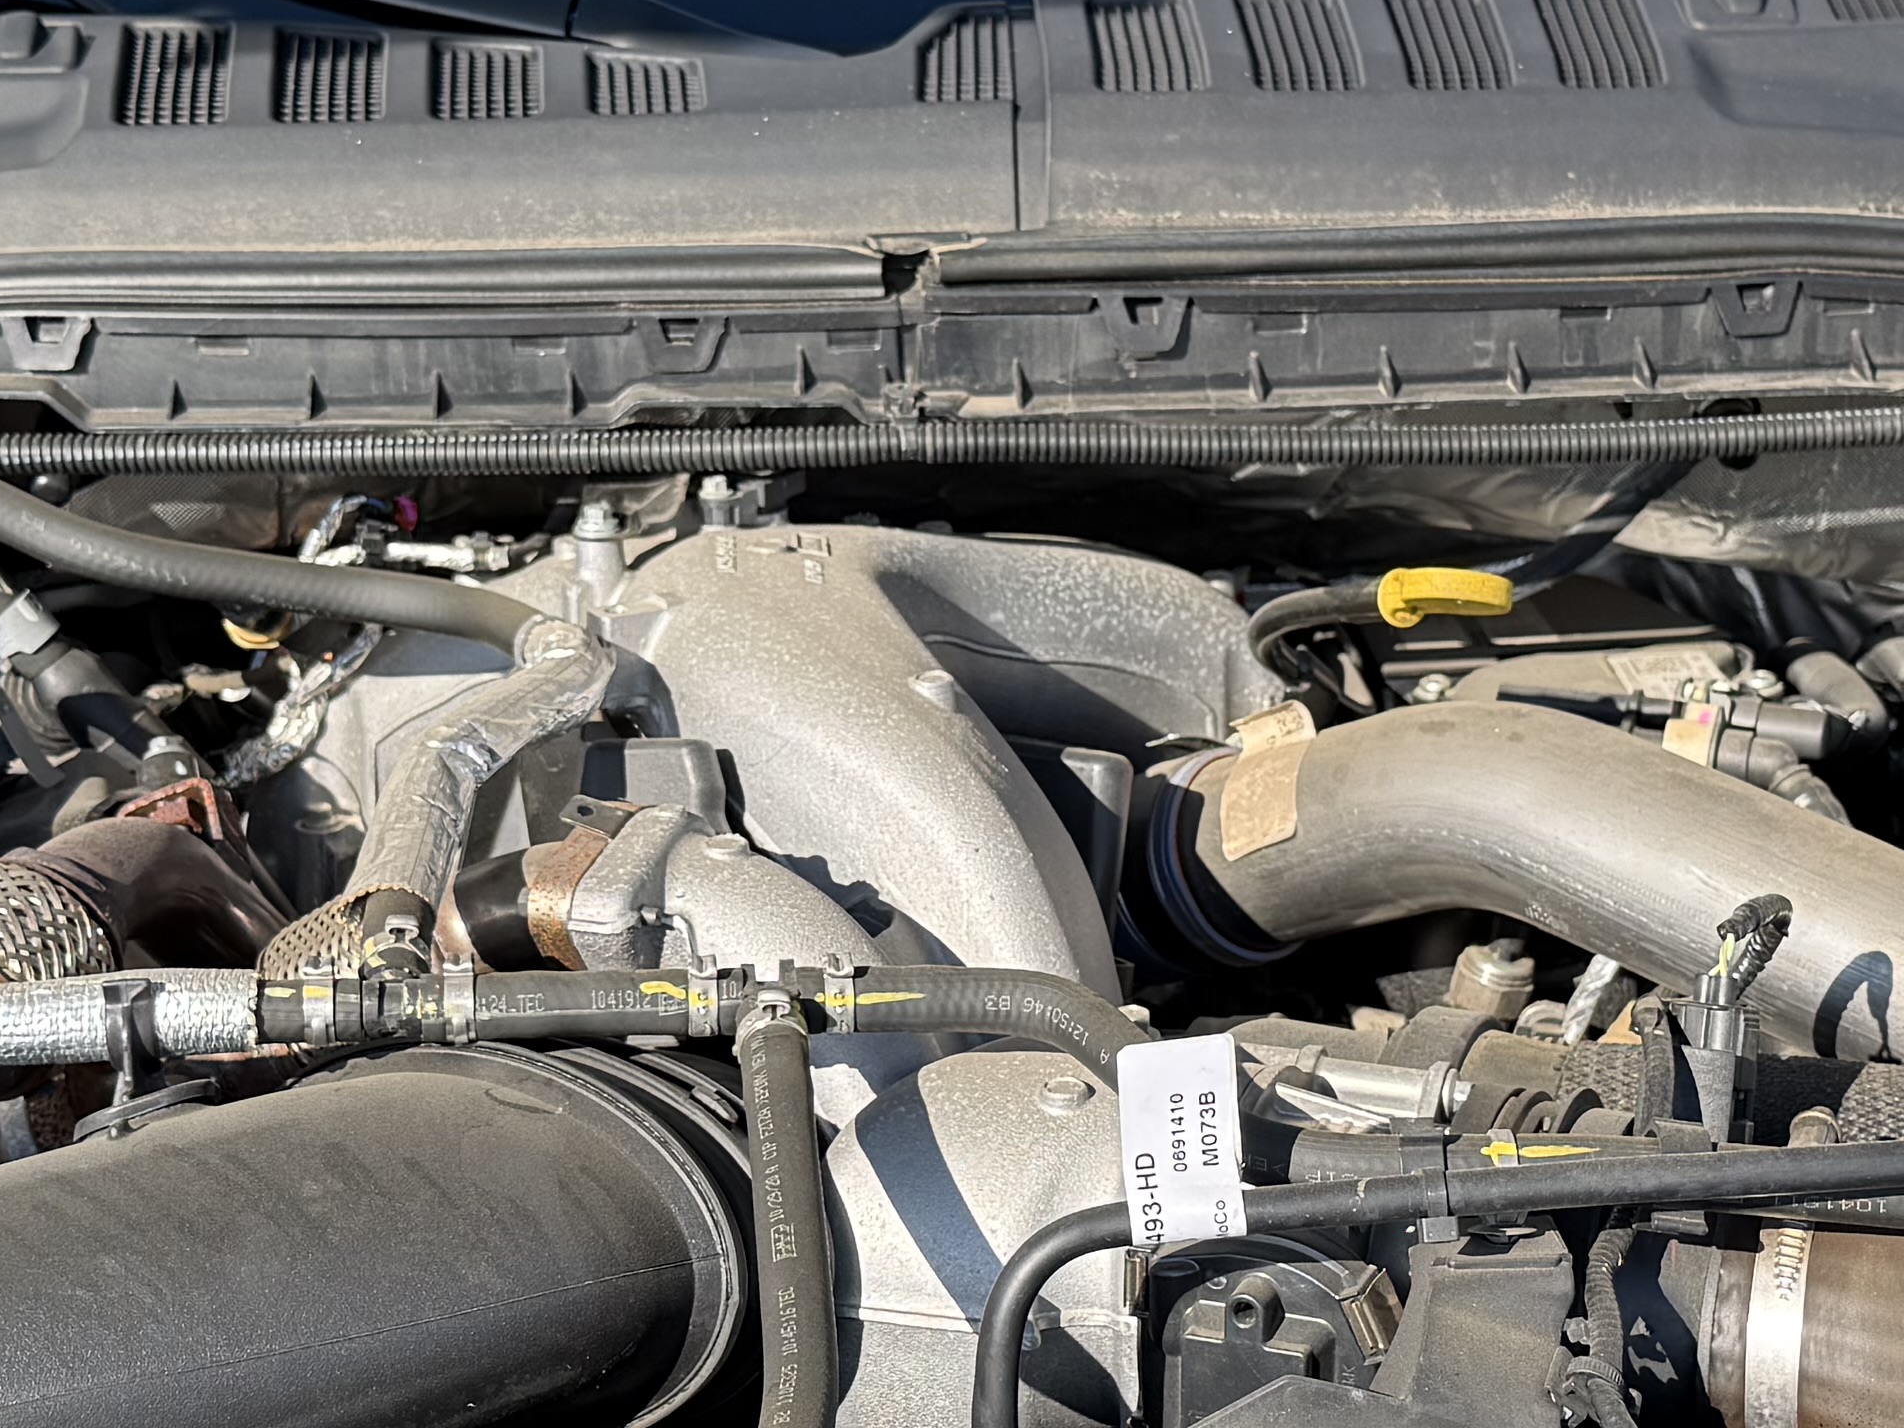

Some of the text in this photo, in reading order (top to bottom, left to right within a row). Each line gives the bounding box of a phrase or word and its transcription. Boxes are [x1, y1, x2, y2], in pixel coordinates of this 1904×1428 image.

[985, 994, 1011, 1012] B3
[1023, 996, 1090, 1048] 12:50:46
[1198, 1090, 1220, 1167] M073B
[1213, 1199, 1229, 1238] oCo
[778, 1286, 796, 1307] TEC
